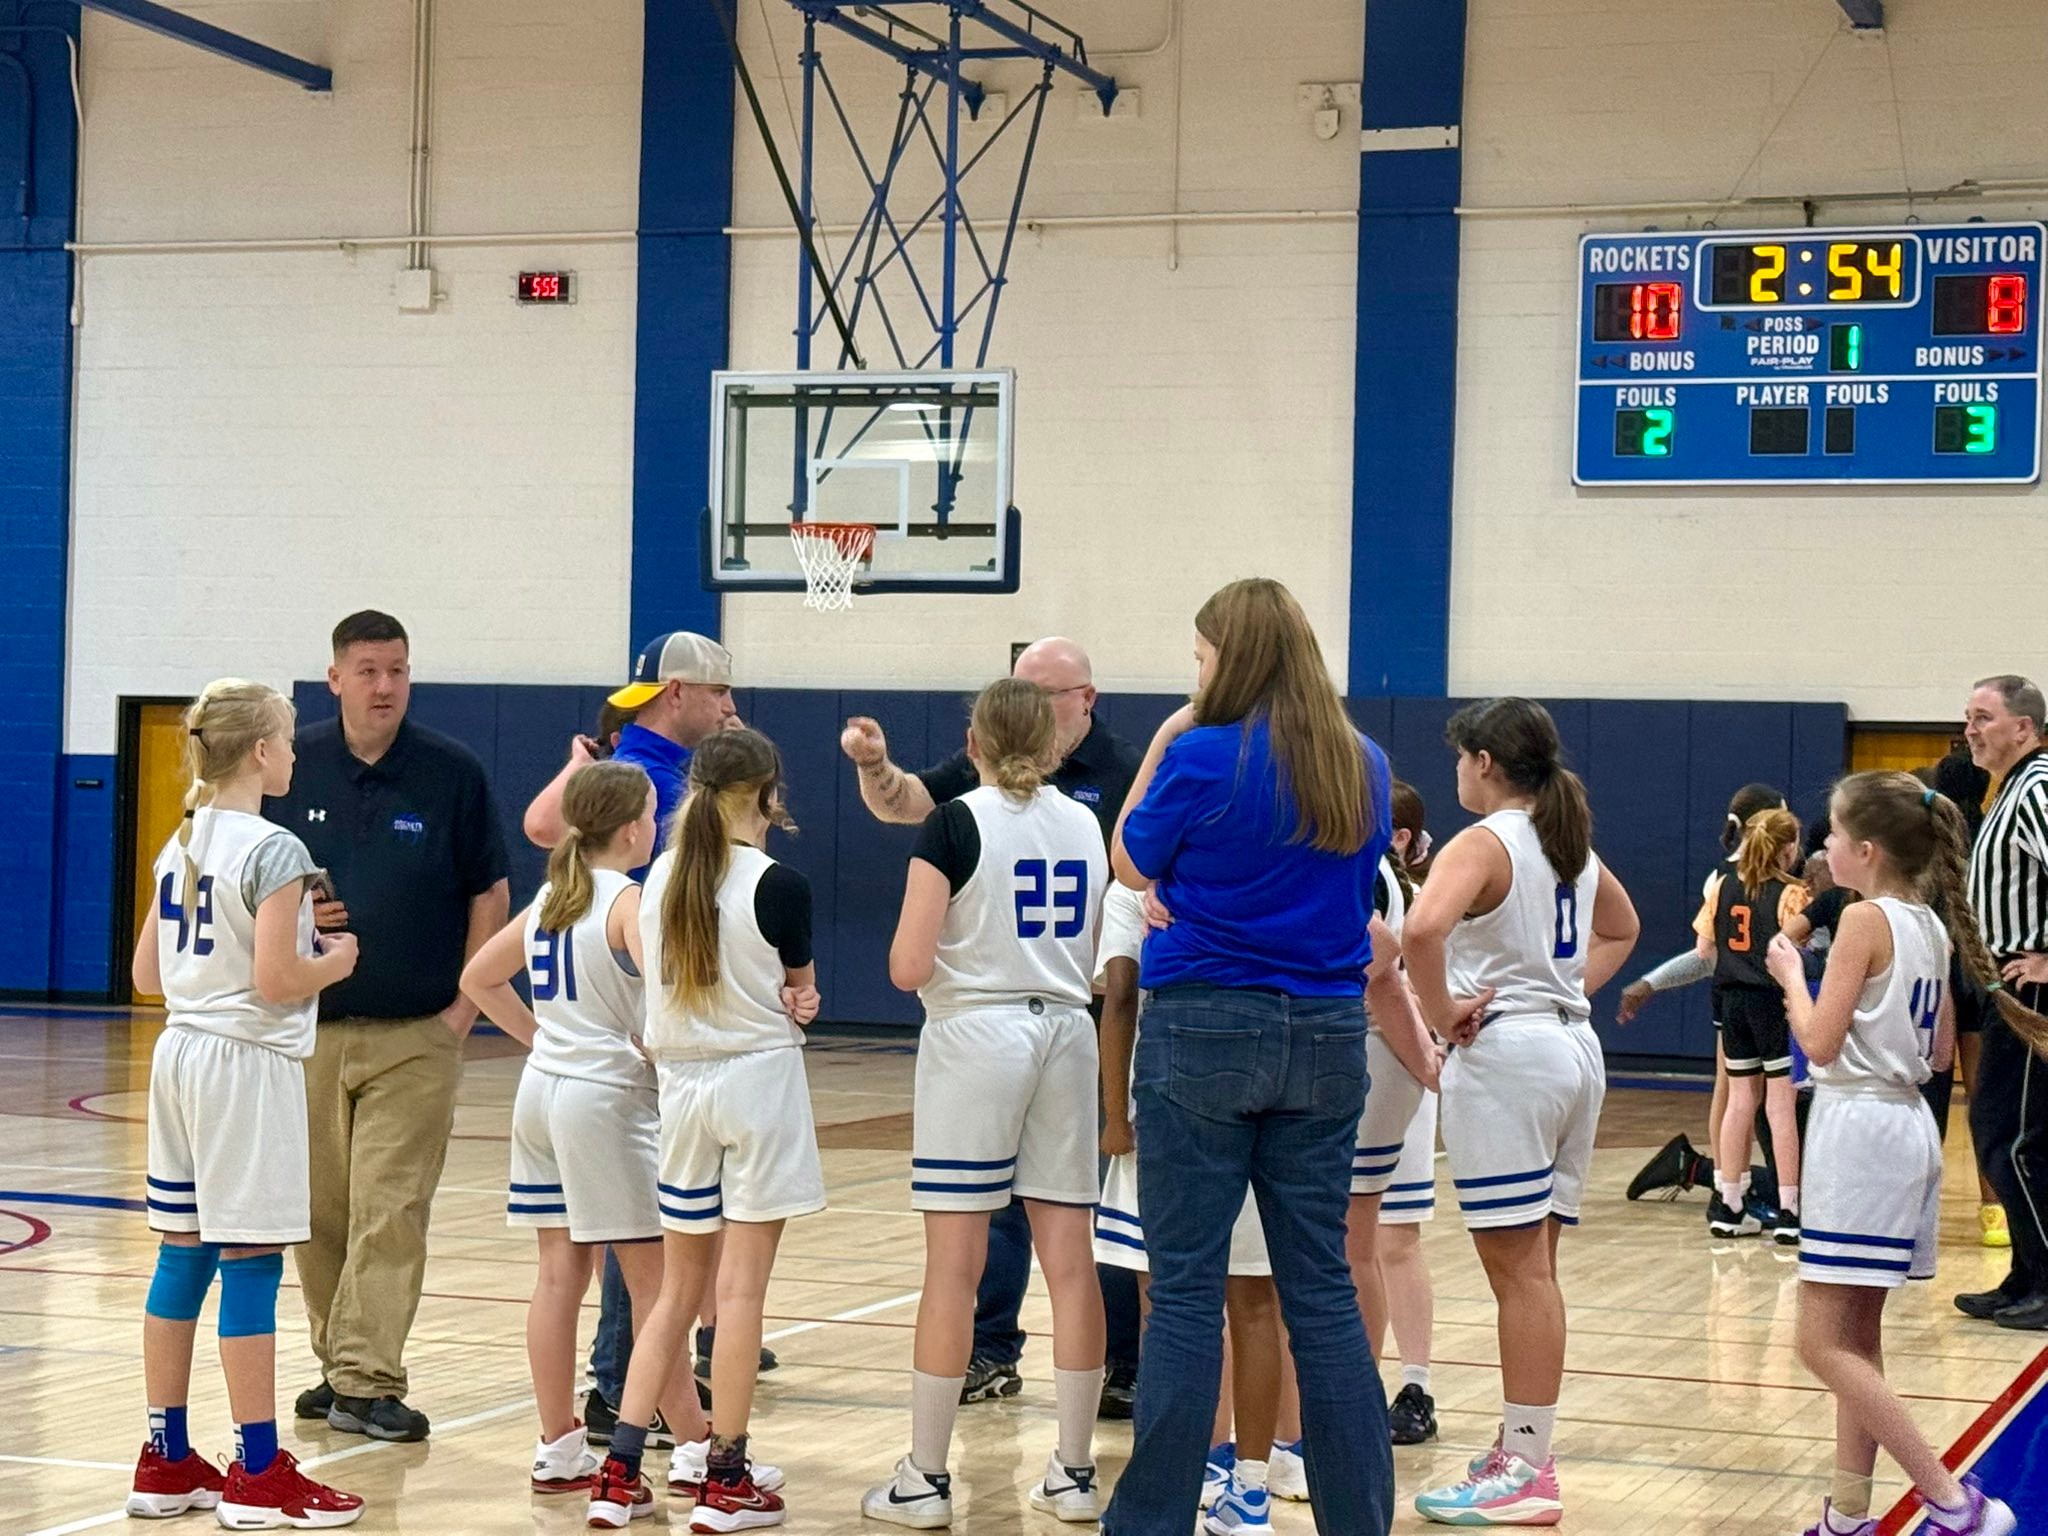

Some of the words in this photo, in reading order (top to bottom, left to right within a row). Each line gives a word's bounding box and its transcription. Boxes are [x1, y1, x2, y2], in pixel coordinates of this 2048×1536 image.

[1590, 245, 1691, 272] ROCKETS
[1751, 243, 1902, 302] 2:54
[1926, 235, 2036, 264] VISITOR
[1629, 283, 1681, 338] 10
[1764, 317, 1804, 332] POSS
[1987, 275, 2025, 333] 8
[1630, 351, 1696, 371] BONUS
[1747, 334, 1820, 355] PERIOD
[1848, 325, 1860, 370] 1
[1915, 345, 1984, 367] BONUS
[1616, 386, 1677, 407] FOULS
[1736, 385, 1810, 405] PLAYER
[1826, 383, 1890, 405] FOULS
[1934, 382, 1999, 403] FOULS
[1643, 409, 1673, 455] 2
[1965, 406, 1995, 452] 3
[160, 872, 215, 956] 42
[1014, 859, 1088, 938] 23
[1553, 881, 1577, 959] 0
[1728, 904, 1751, 951] 3
[532, 925, 578, 1001] 31
[1909, 976, 1942, 1060] 14
